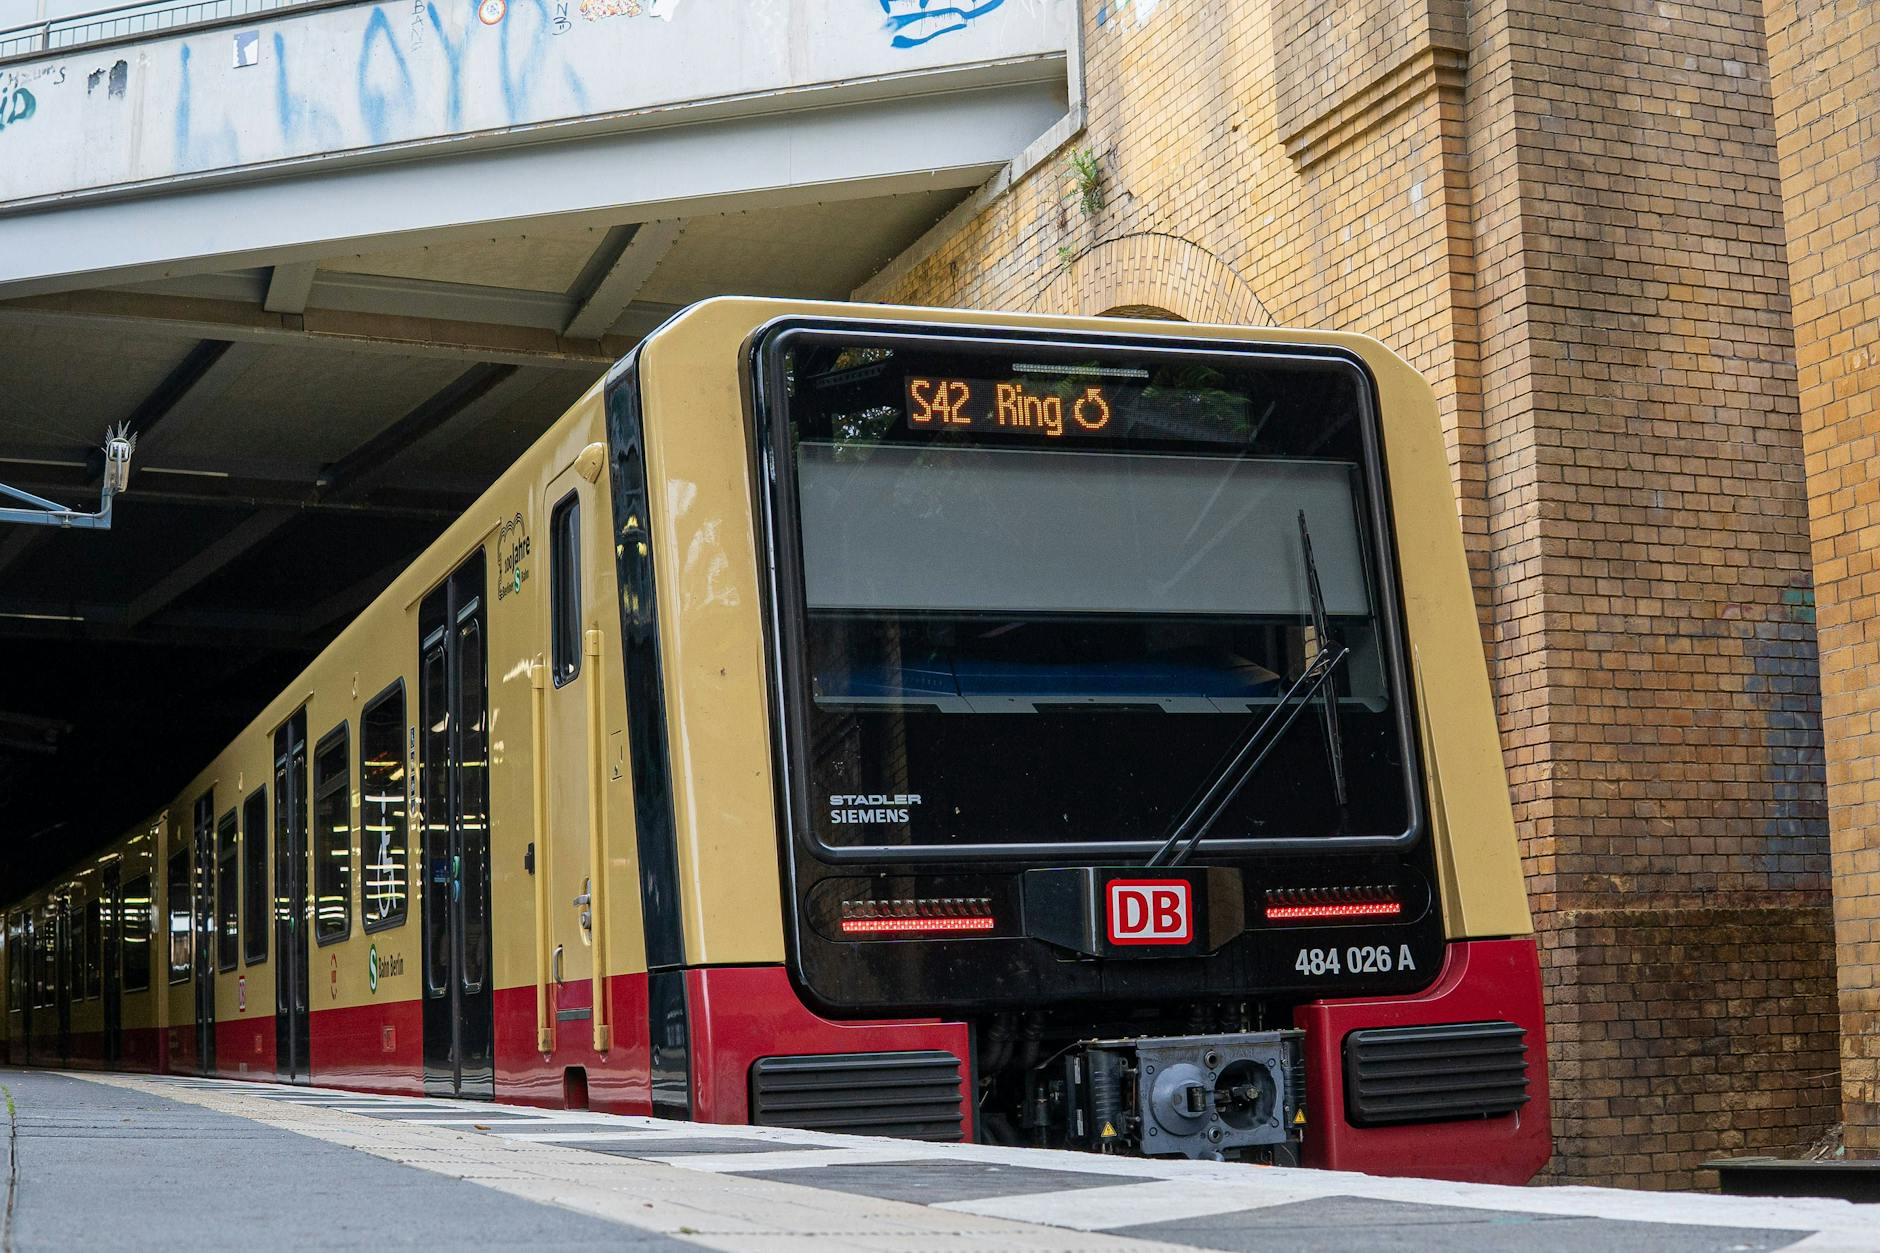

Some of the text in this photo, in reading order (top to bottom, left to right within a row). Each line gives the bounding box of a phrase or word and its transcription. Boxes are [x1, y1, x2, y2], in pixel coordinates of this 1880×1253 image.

[911, 379, 1064, 436] S42 Ring
[511, 535, 530, 574] Jahre
[829, 794, 922, 806] STADLER
[830, 808, 910, 824] SIEMENS
[1117, 890, 1183, 934] DB
[1295, 944, 1417, 976] 484 026 A
